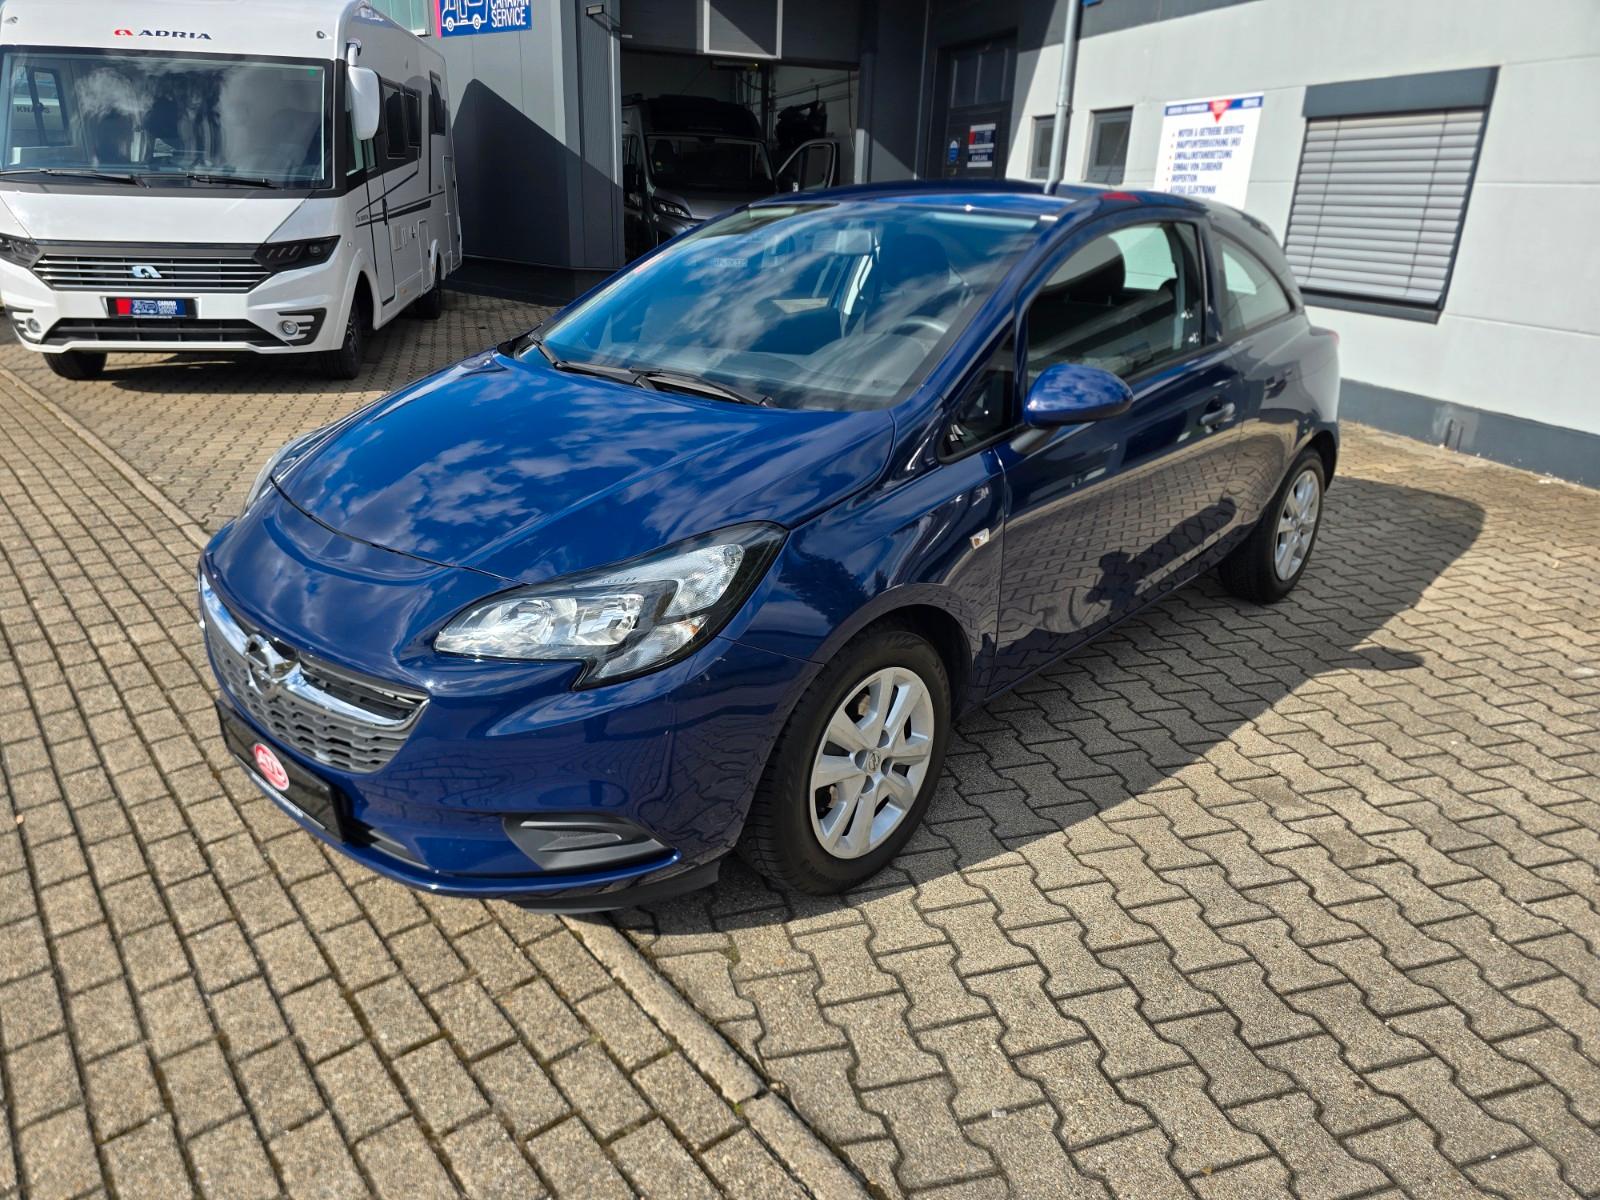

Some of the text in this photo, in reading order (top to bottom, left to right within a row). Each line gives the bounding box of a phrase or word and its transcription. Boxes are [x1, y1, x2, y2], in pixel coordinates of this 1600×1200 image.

[491, 7, 527, 28] SERVICE
[138, 29, 212, 40] ADRIA
[16, 105, 51, 113] KNS
[1178, 128, 1193, 137] MOTOR
[1223, 124, 1245, 135] SERVICE
[1190, 162, 1199, 171] VON
